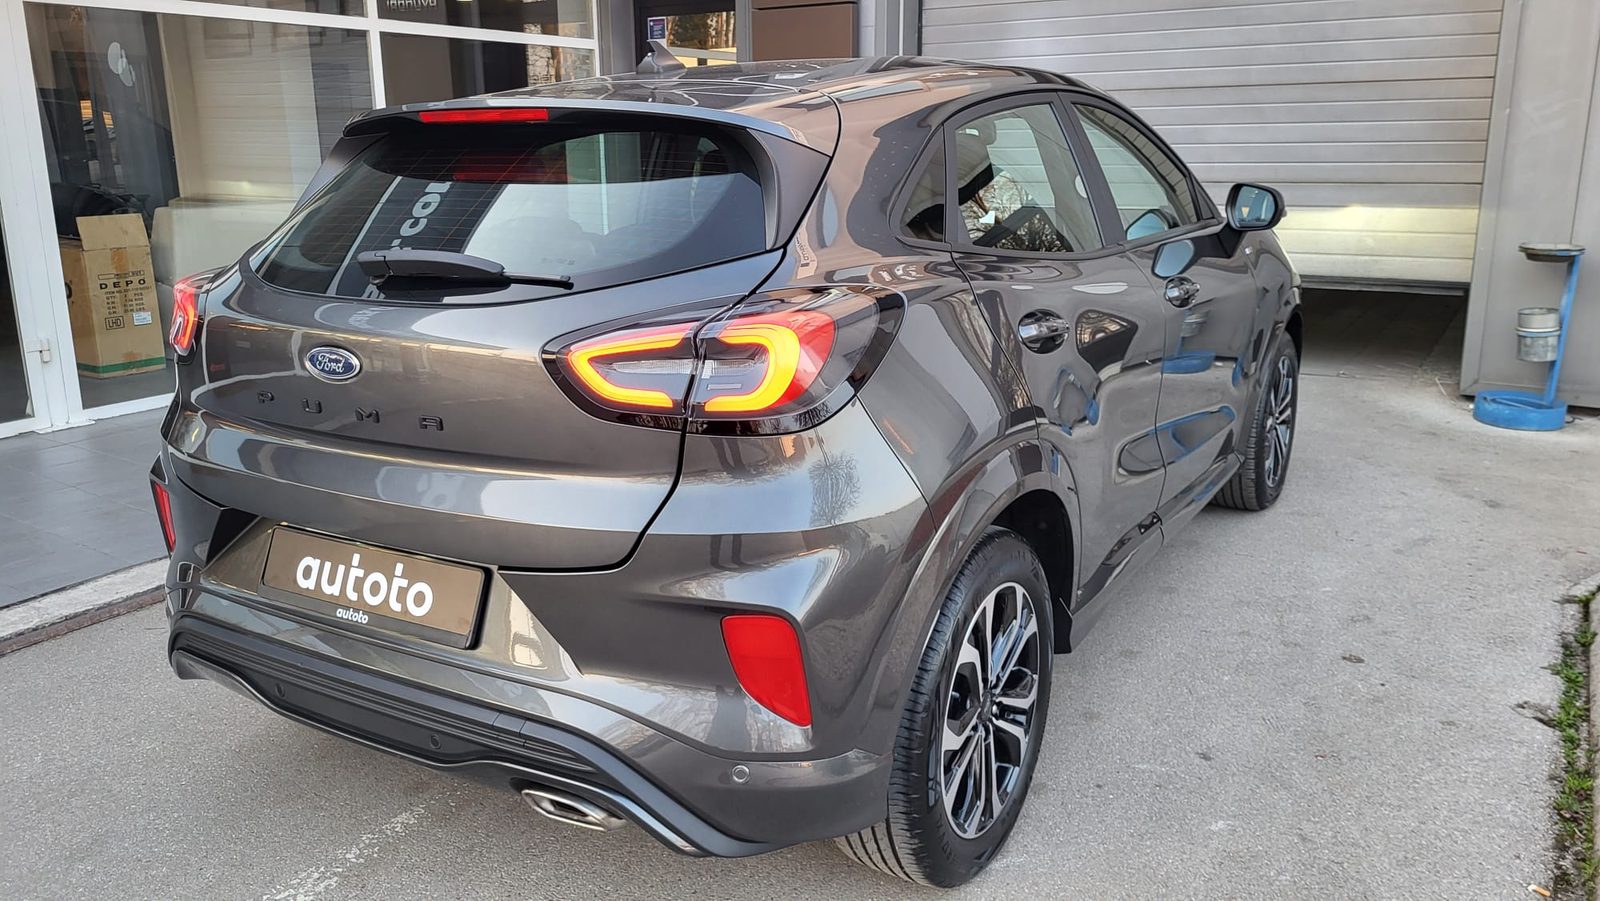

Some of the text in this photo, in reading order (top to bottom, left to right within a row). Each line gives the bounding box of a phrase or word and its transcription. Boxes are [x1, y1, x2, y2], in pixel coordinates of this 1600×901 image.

[99, 279, 146, 290] DEPO
[108, 318, 121, 328] LHD
[316, 352, 346, 373] Ford
[257, 391, 444, 431] PUMA
[296, 552, 434, 617] autoto
[336, 607, 369, 625] autoto
